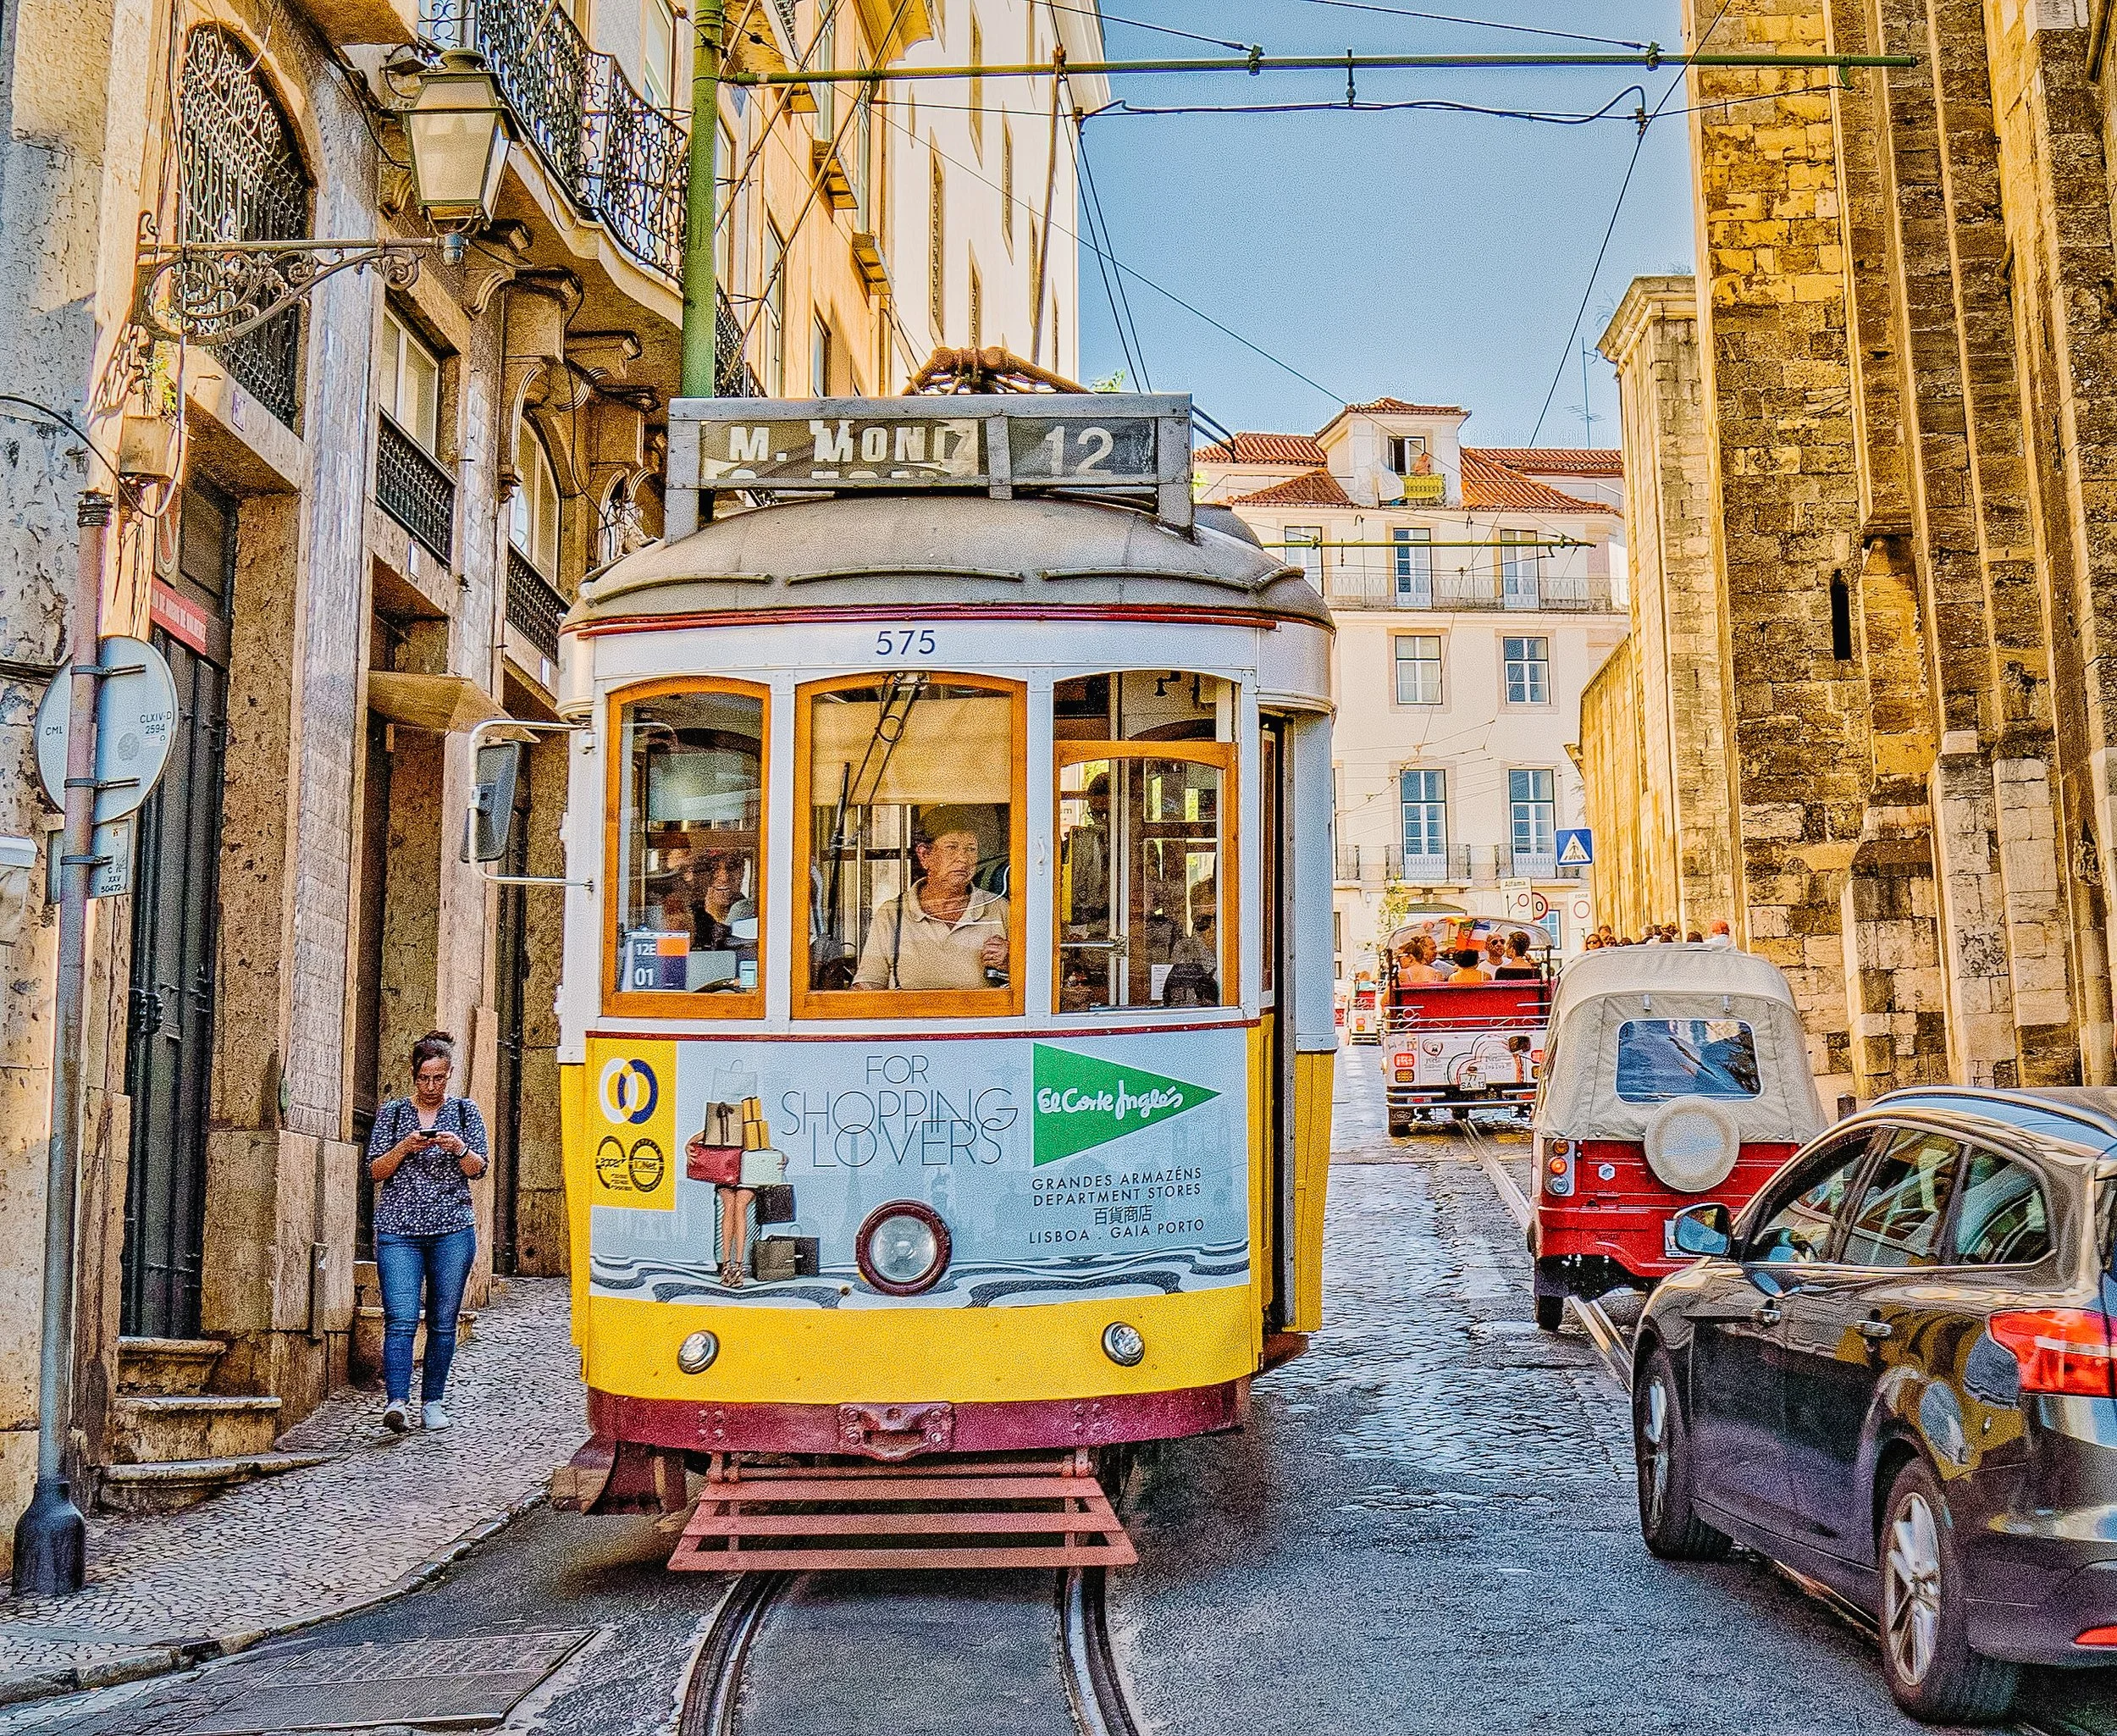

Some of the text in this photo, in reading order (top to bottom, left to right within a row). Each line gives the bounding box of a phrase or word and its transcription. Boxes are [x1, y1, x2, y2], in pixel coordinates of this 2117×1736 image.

[729, 426, 788, 462] M.
[1044, 425, 1114, 476] 12
[875, 630, 937, 655] 575
[46, 726, 64, 735] CML
[636, 943, 656, 955] 12E
[635, 967, 655, 987] 01
[866, 1055, 929, 1085] FOR
[781, 1087, 1019, 1136] SHOPPING
[1036, 1086, 1062, 1114] El
[813, 1118, 1002, 1168] LOVERS
[1032, 1166, 1202, 1191] GRANDES ARMAZÉNS
[1033, 1183, 1201, 1207] DEPARTMENT STORES
[1093, 1204, 1153, 1225] 百貨商店
[1029, 1219, 1204, 1244] LISBOA GAIA PORTO
